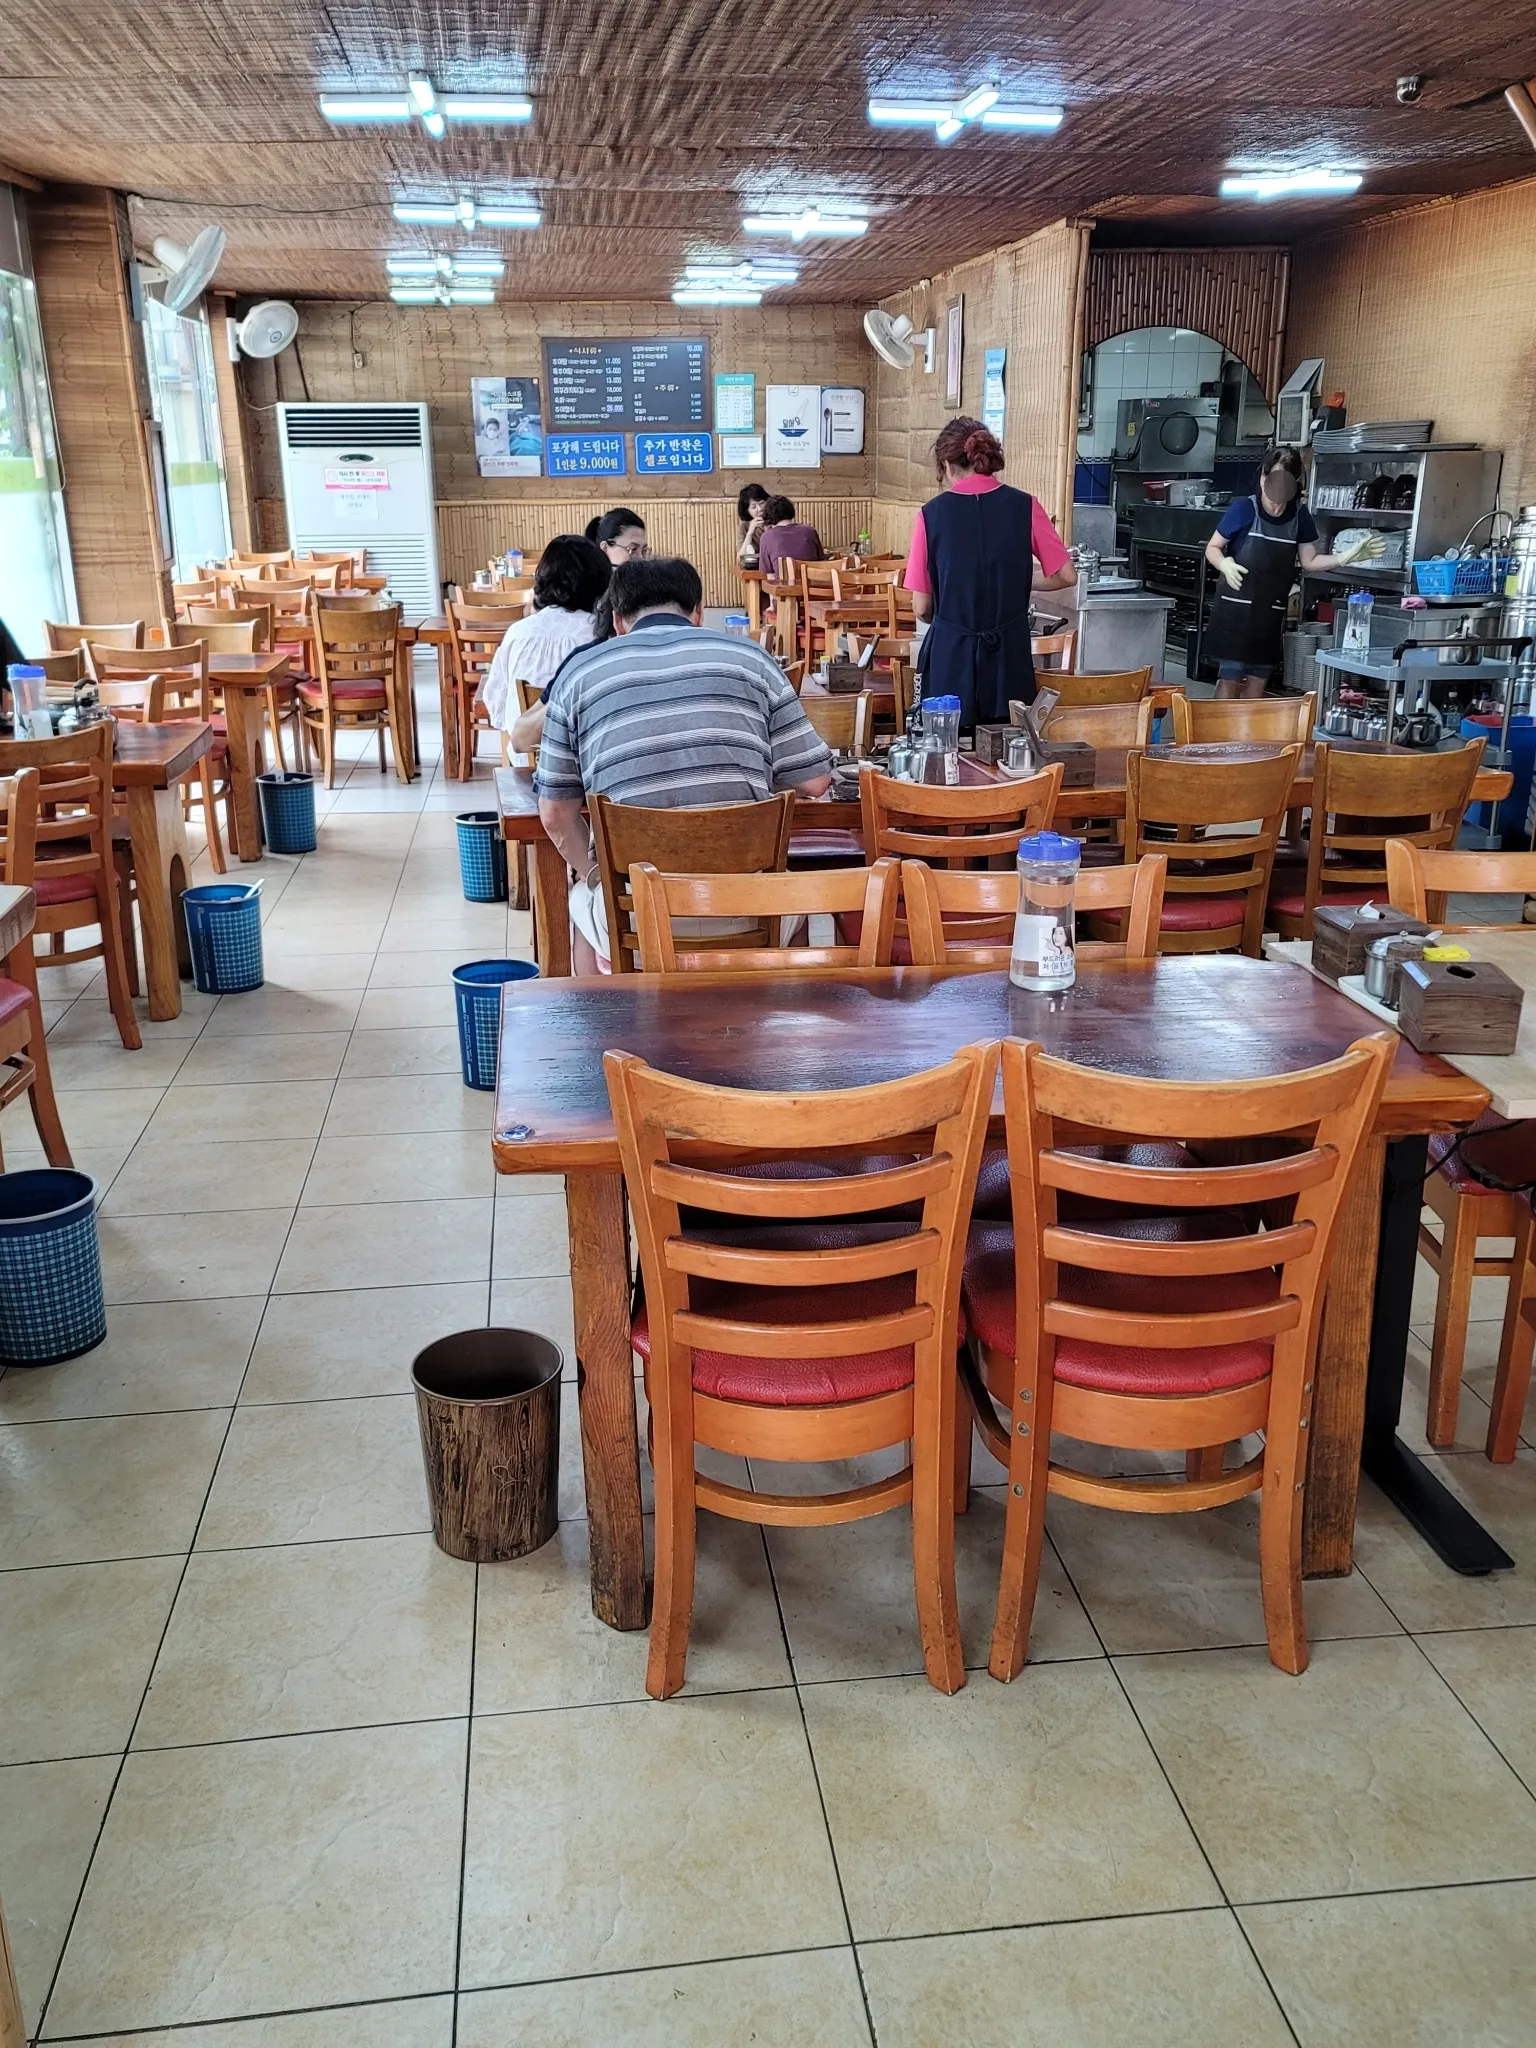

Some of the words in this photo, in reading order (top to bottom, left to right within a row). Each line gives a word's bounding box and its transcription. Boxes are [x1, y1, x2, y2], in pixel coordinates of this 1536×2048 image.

[551, 440, 580, 454] 포장해
[582, 440, 620, 454] 드립니다
[644, 440, 666, 452] 추가
[669, 439, 703, 451] 반찬은
[555, 458, 577, 470] 1인분
[580, 457, 618, 469] 9.000원
